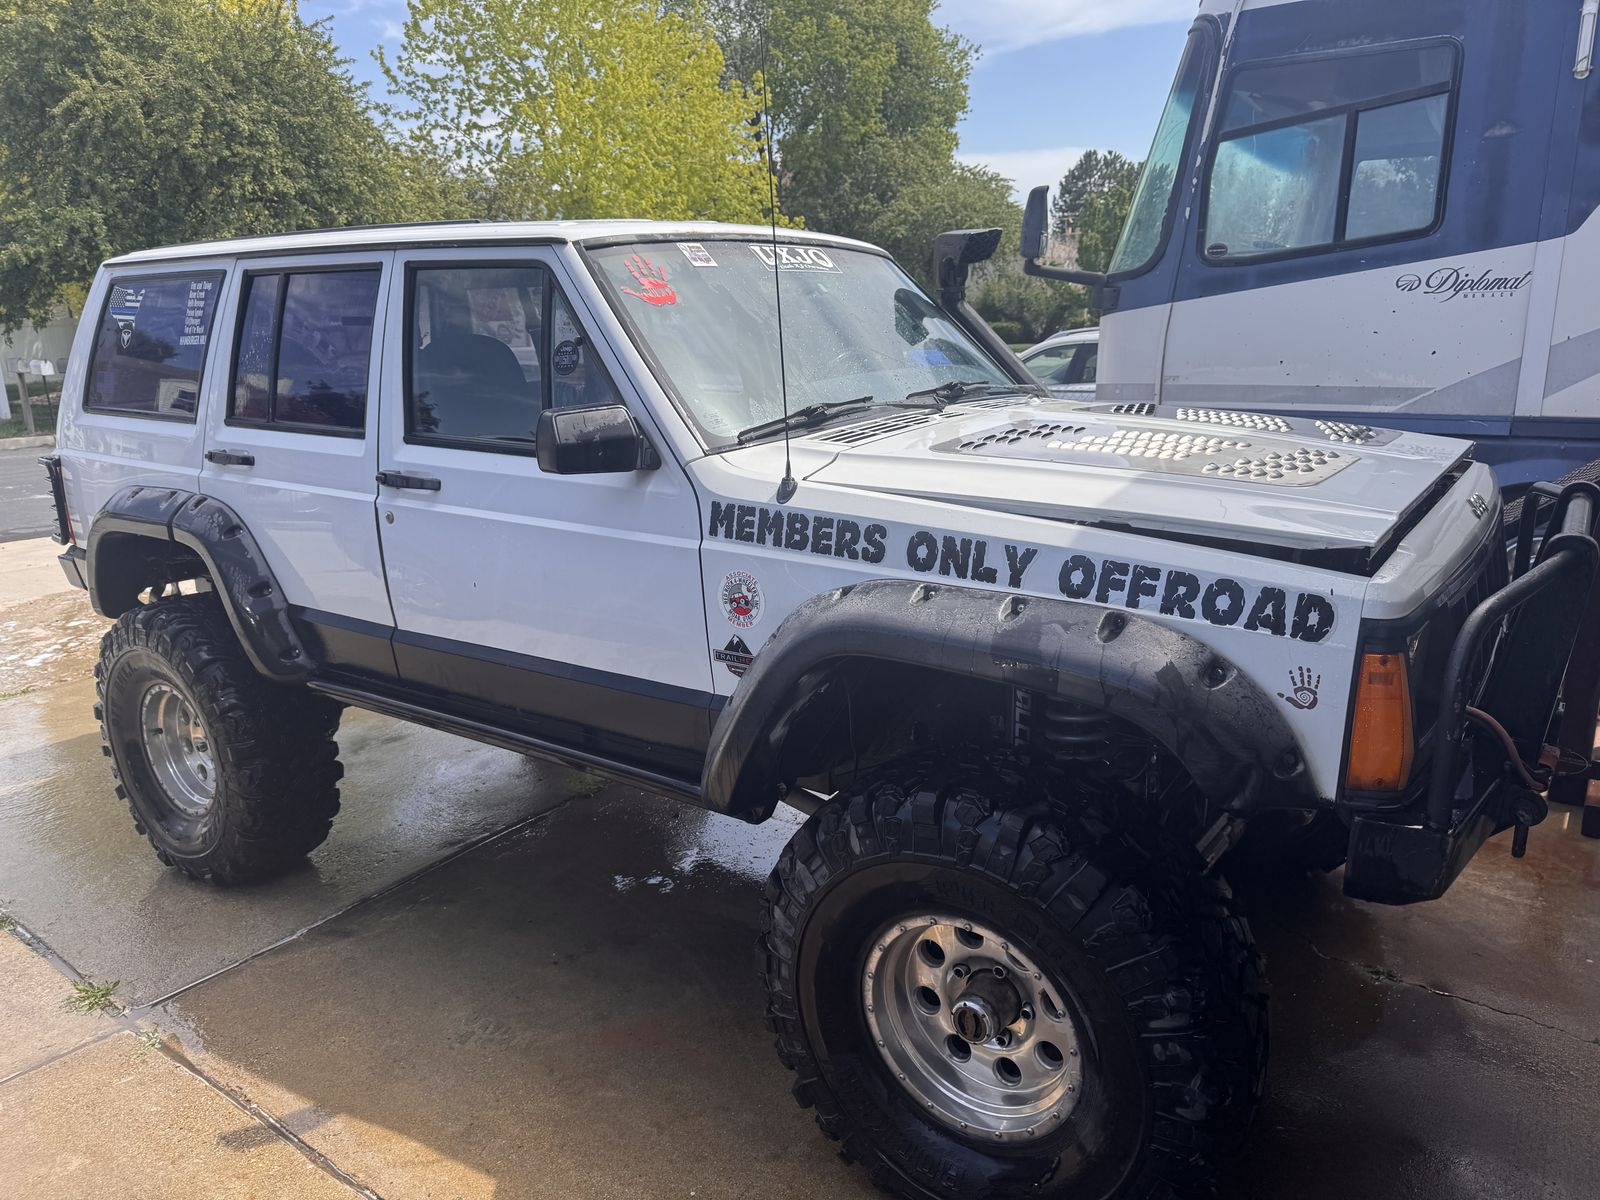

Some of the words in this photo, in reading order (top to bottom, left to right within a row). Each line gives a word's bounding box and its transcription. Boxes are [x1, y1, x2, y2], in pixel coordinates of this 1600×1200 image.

[1423, 266, 1533, 303] Diplomat
[708, 500, 888, 564] MEMBERS
[906, 531, 1038, 589] ONLY
[1058, 555, 1334, 642] OFFROAD
[725, 570, 759, 585] ASSOCIATE
[727, 616, 754, 628] MEMBER
